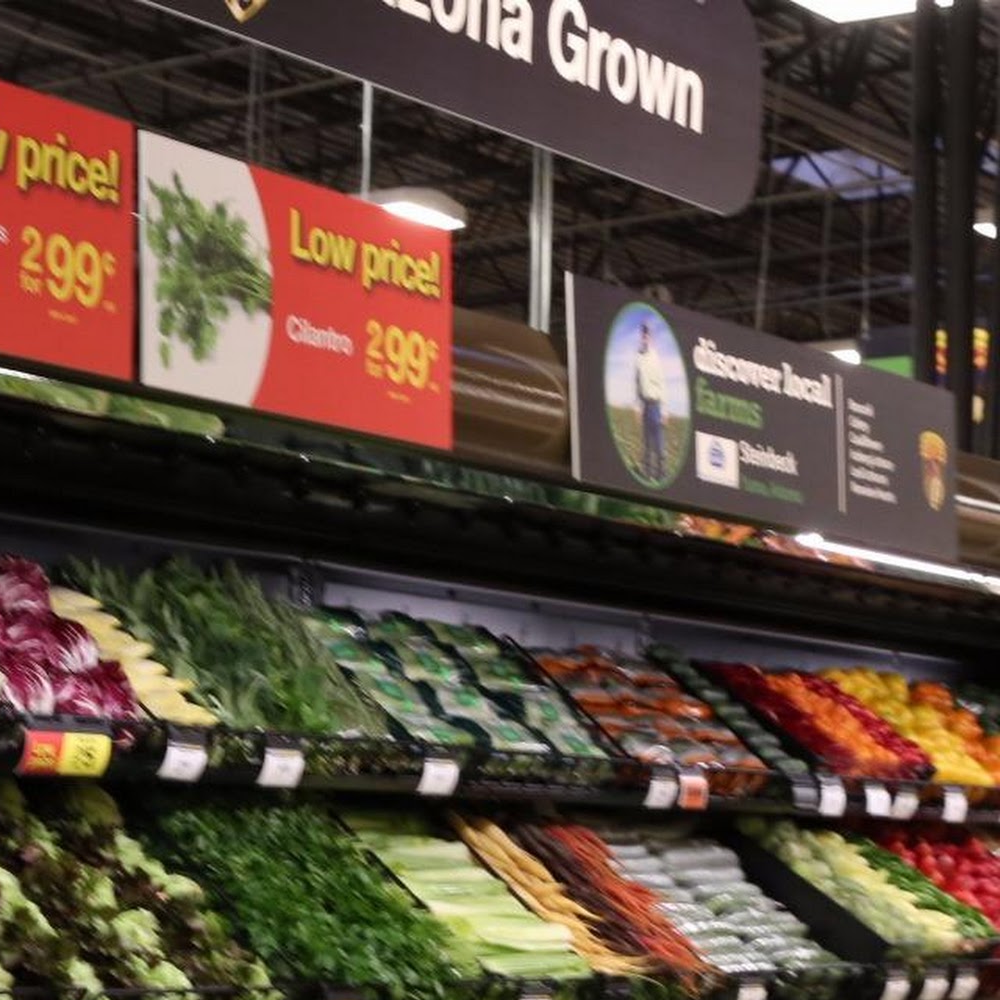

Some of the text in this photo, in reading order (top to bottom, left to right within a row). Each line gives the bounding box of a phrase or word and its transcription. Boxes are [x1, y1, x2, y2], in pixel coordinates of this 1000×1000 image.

[548, 0, 703, 134] Grown
[16, 132, 119, 204] price!
[290, 206, 441, 299] Low price!
[286, 314, 354, 357] Cilantro
[693, 336, 833, 409] discover local
[695, 375, 763, 430] farms
